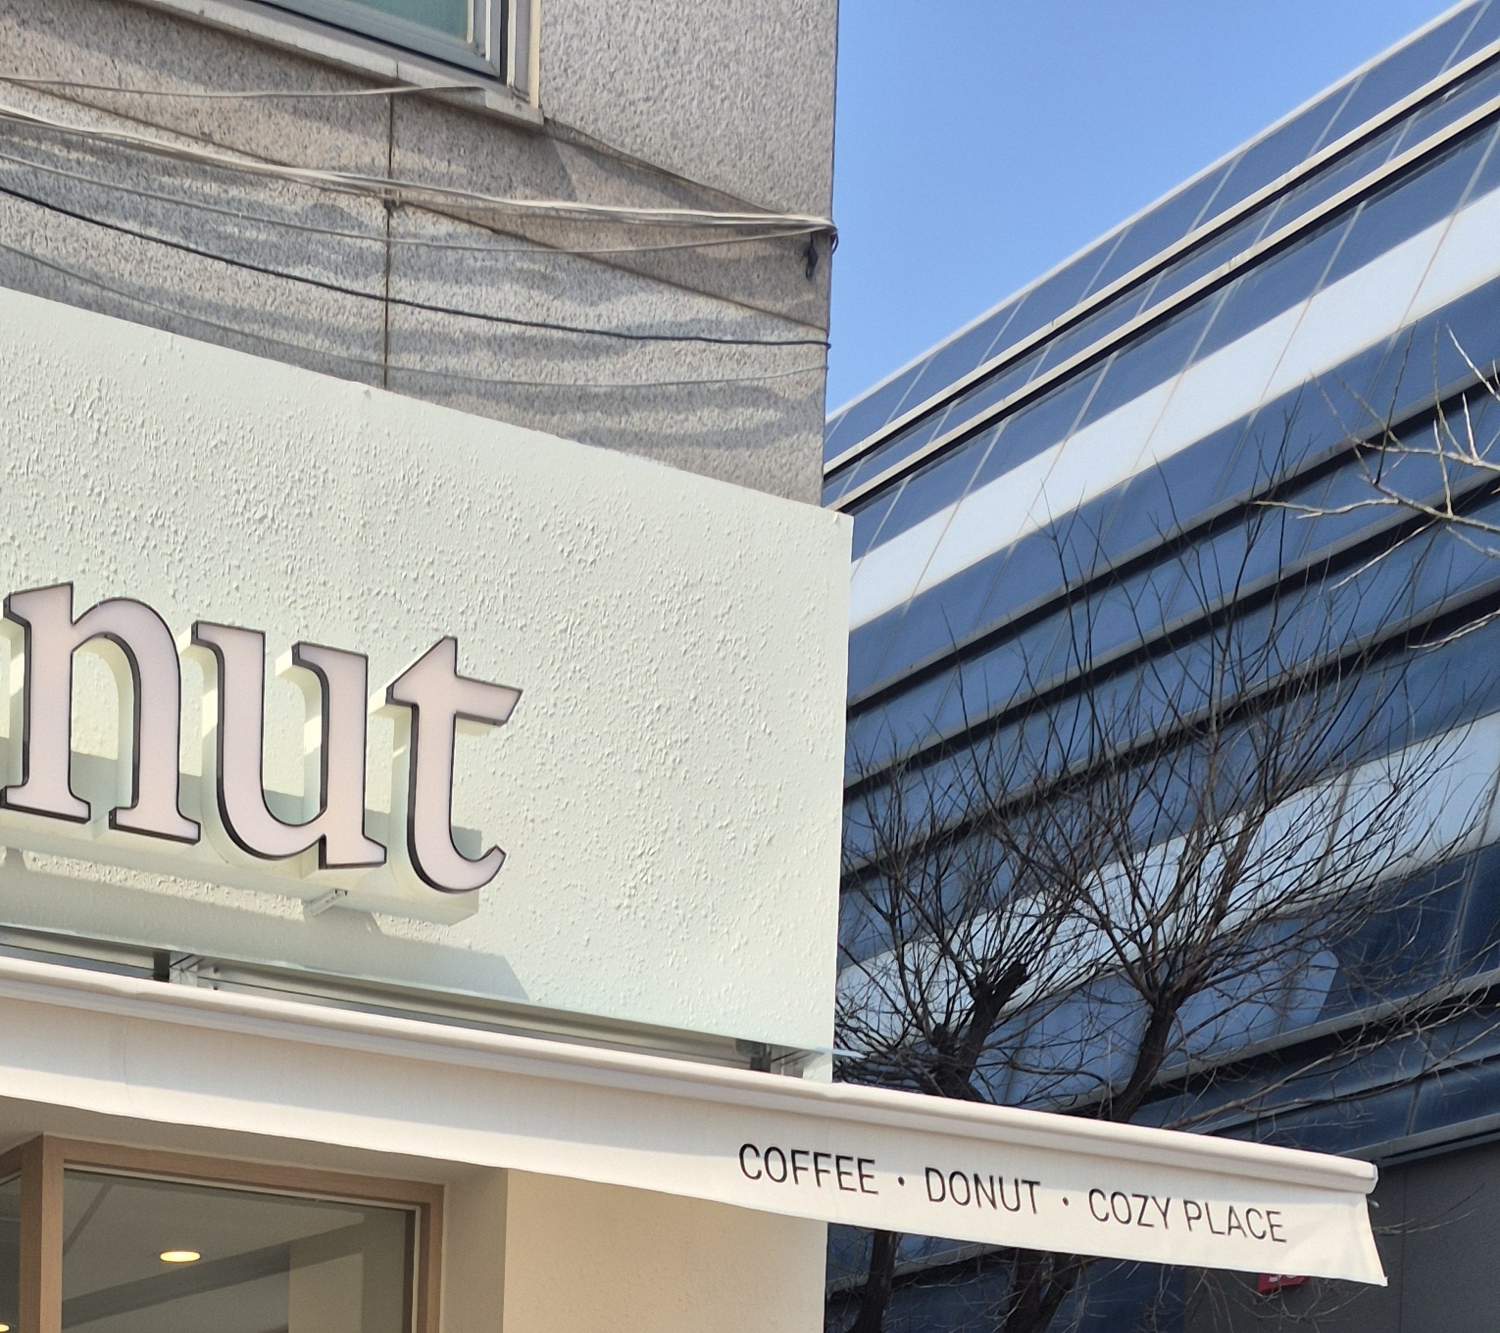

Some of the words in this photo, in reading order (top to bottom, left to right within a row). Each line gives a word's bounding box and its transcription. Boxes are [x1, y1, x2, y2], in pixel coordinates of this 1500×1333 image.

[738, 1143, 880, 1195] COFFEE
[925, 1167, 1041, 1215] DONUT
[1088, 1188, 1171, 1230] COZY
[1183, 1200, 1288, 1245] PLACE
